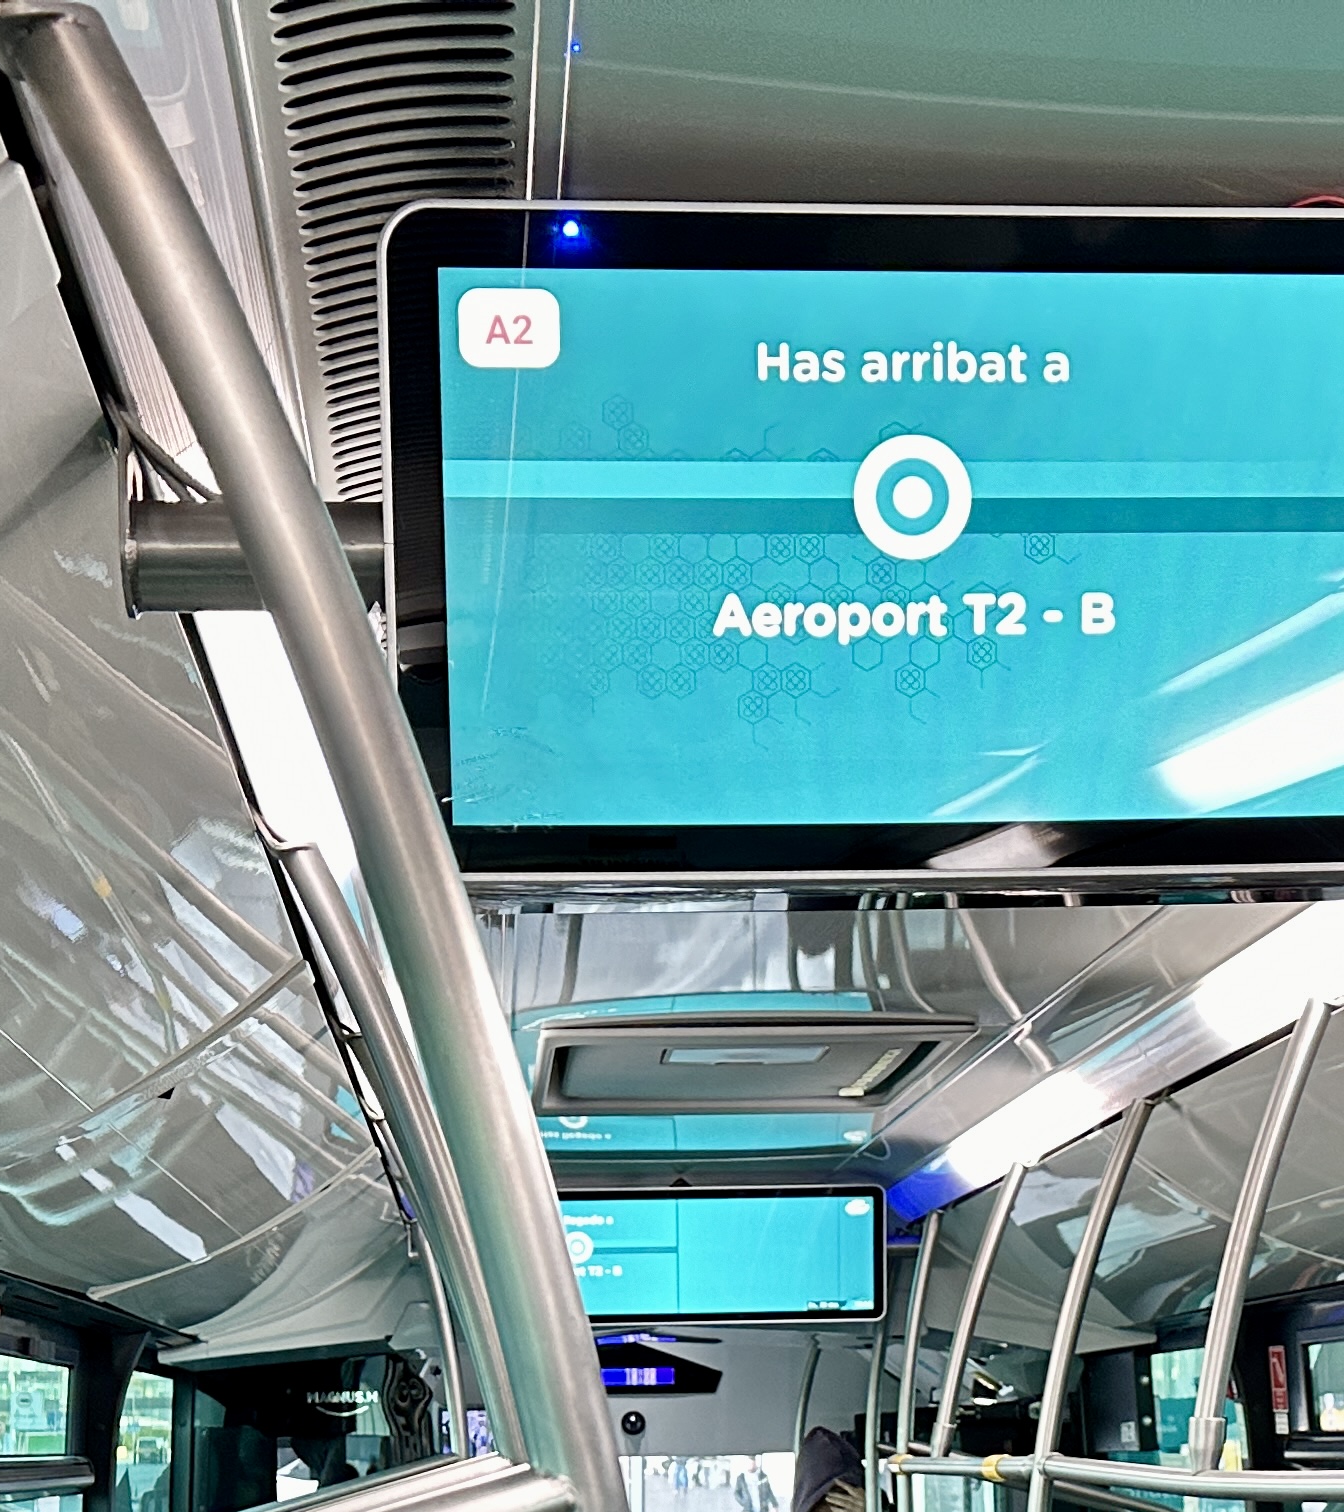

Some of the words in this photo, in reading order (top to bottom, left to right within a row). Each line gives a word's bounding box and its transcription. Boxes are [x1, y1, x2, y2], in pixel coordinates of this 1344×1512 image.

[485, 314, 533, 345] A2
[757, 343, 846, 382] Has
[861, 341, 1027, 383] arribat
[1043, 352, 1069, 383] a
[713, 593, 947, 645] Aeroport
[963, 592, 1026, 635] T2
[1043, 610, 1063, 623] -
[1081, 592, 1116, 634] B
